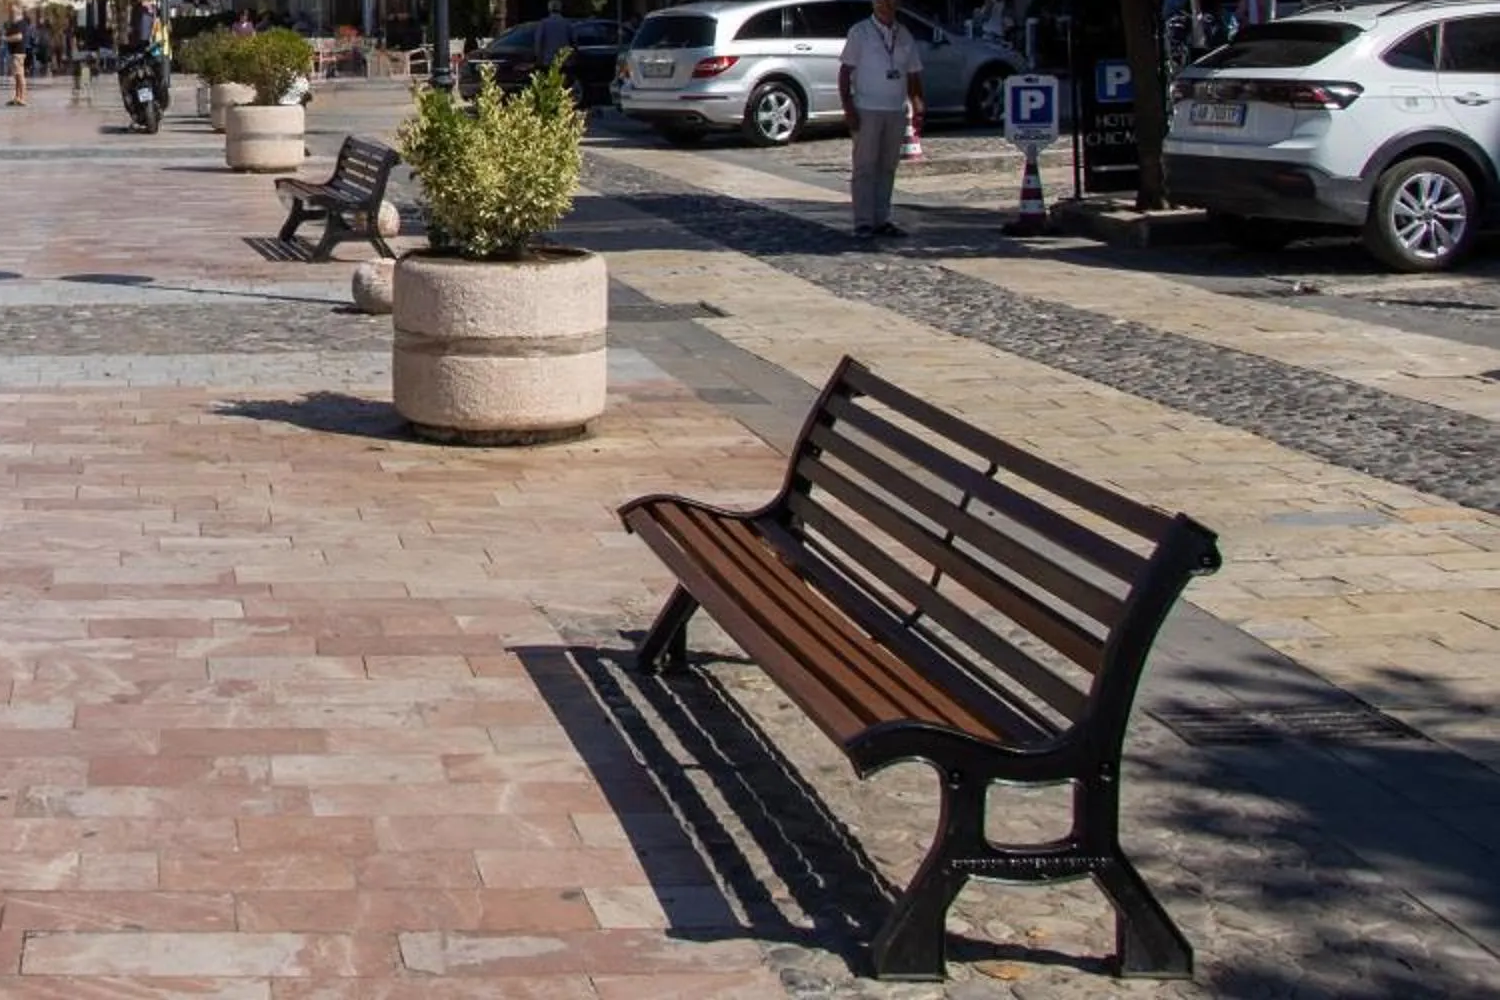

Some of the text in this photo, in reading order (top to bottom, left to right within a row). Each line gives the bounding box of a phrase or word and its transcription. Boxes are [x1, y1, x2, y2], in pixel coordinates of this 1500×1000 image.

[1105, 65, 1132, 97] P
[1019, 89, 1045, 120] P
[1086, 131, 1138, 146] CHICA
